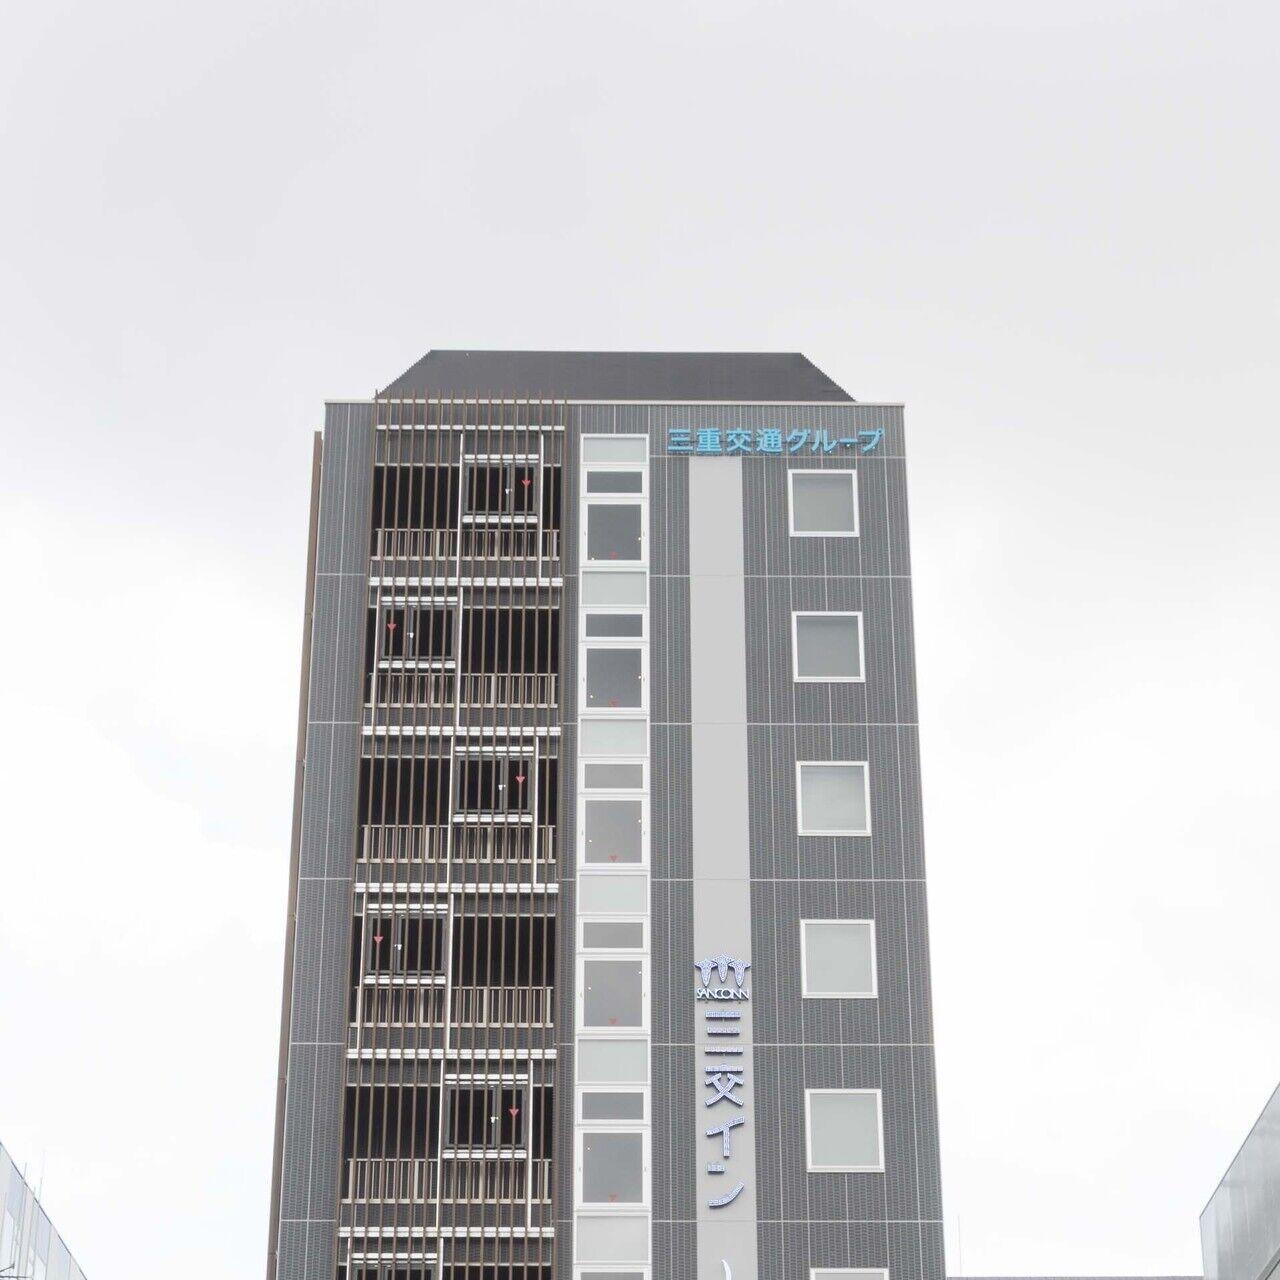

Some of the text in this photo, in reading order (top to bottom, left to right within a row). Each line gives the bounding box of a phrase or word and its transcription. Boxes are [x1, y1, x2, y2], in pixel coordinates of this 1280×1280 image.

[668, 428, 884, 453] 三重交通グループ
[704, 1009, 745, 1209] 三交イン
